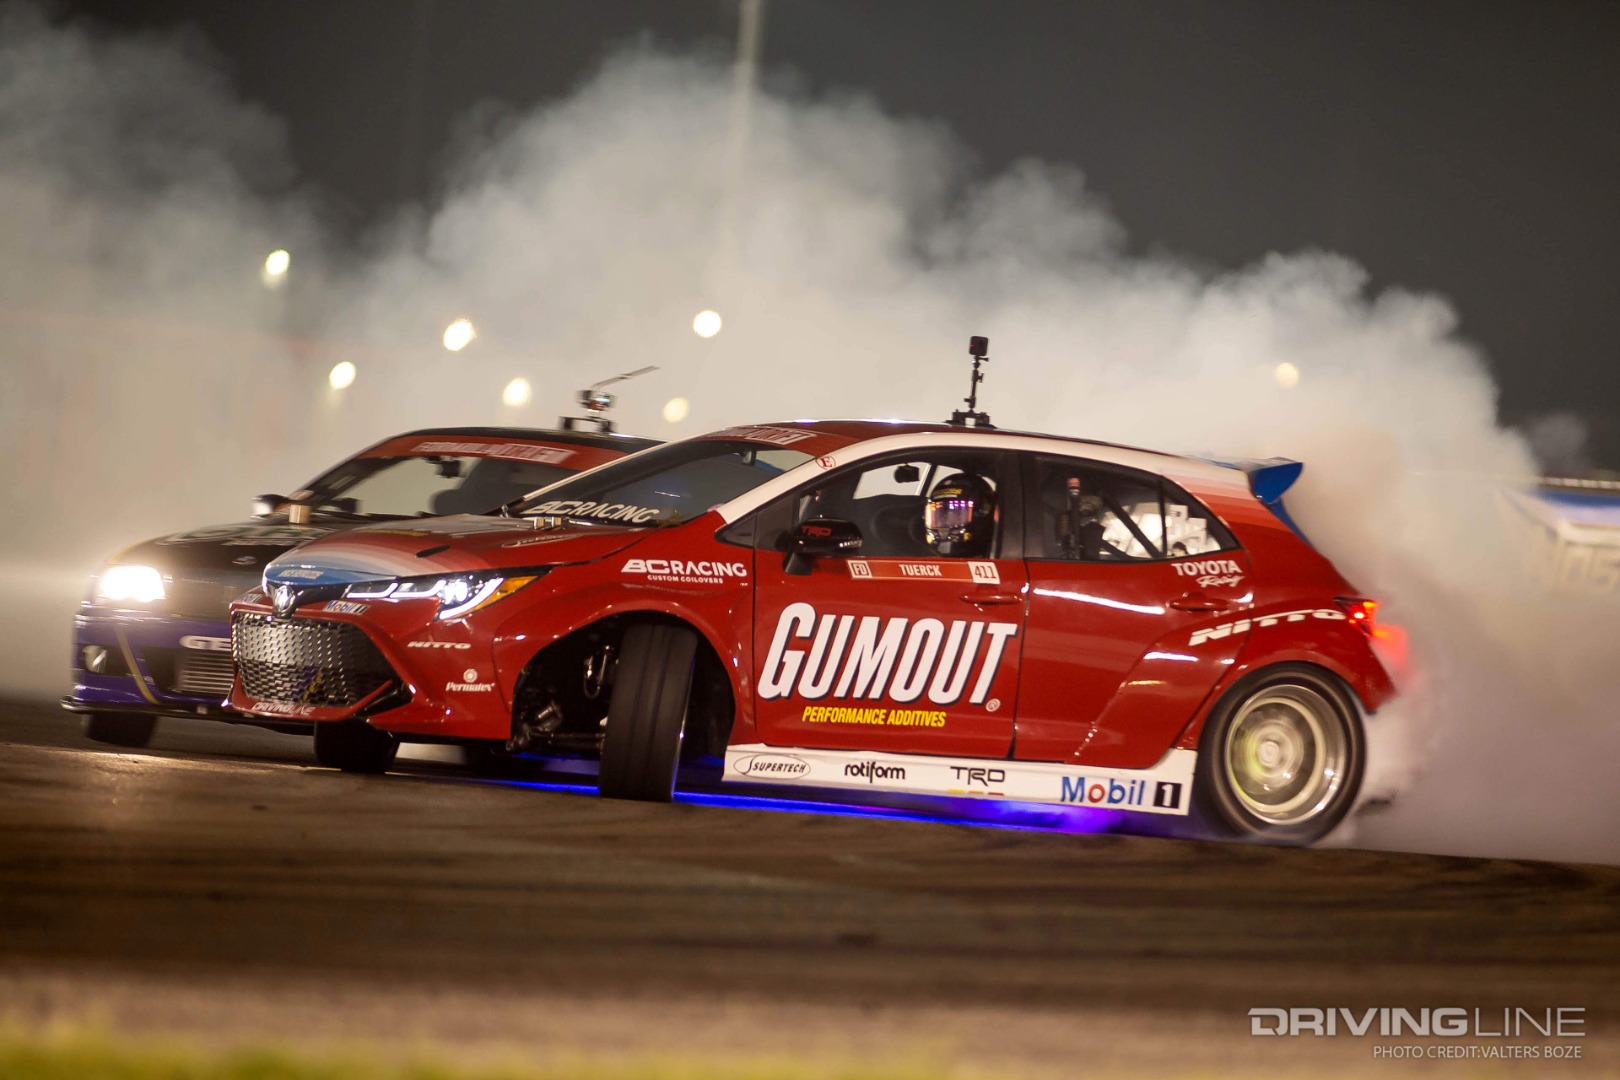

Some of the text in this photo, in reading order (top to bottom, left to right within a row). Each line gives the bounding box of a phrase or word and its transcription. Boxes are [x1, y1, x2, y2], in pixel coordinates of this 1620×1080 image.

[801, 525, 832, 537] TRD
[899, 564, 942, 577] TUERCK
[974, 564, 997, 579] 411
[1170, 560, 1243, 576] TOYOTA
[647, 574, 724, 584] CUSTOM COILOVERS
[323, 600, 354, 613] Mobil
[1188, 609, 1347, 646] NITTO
[407, 641, 472, 649] NITTO
[757, 602, 1018, 704] GUMOUT
[802, 706, 947, 727] PERFORMANCE ADDITIVES
[753, 761, 806, 773] SUPERTECH
[844, 761, 906, 784] rotiform
[950, 766, 1006, 787] TRD
[1060, 776, 1146, 806] Mobil
